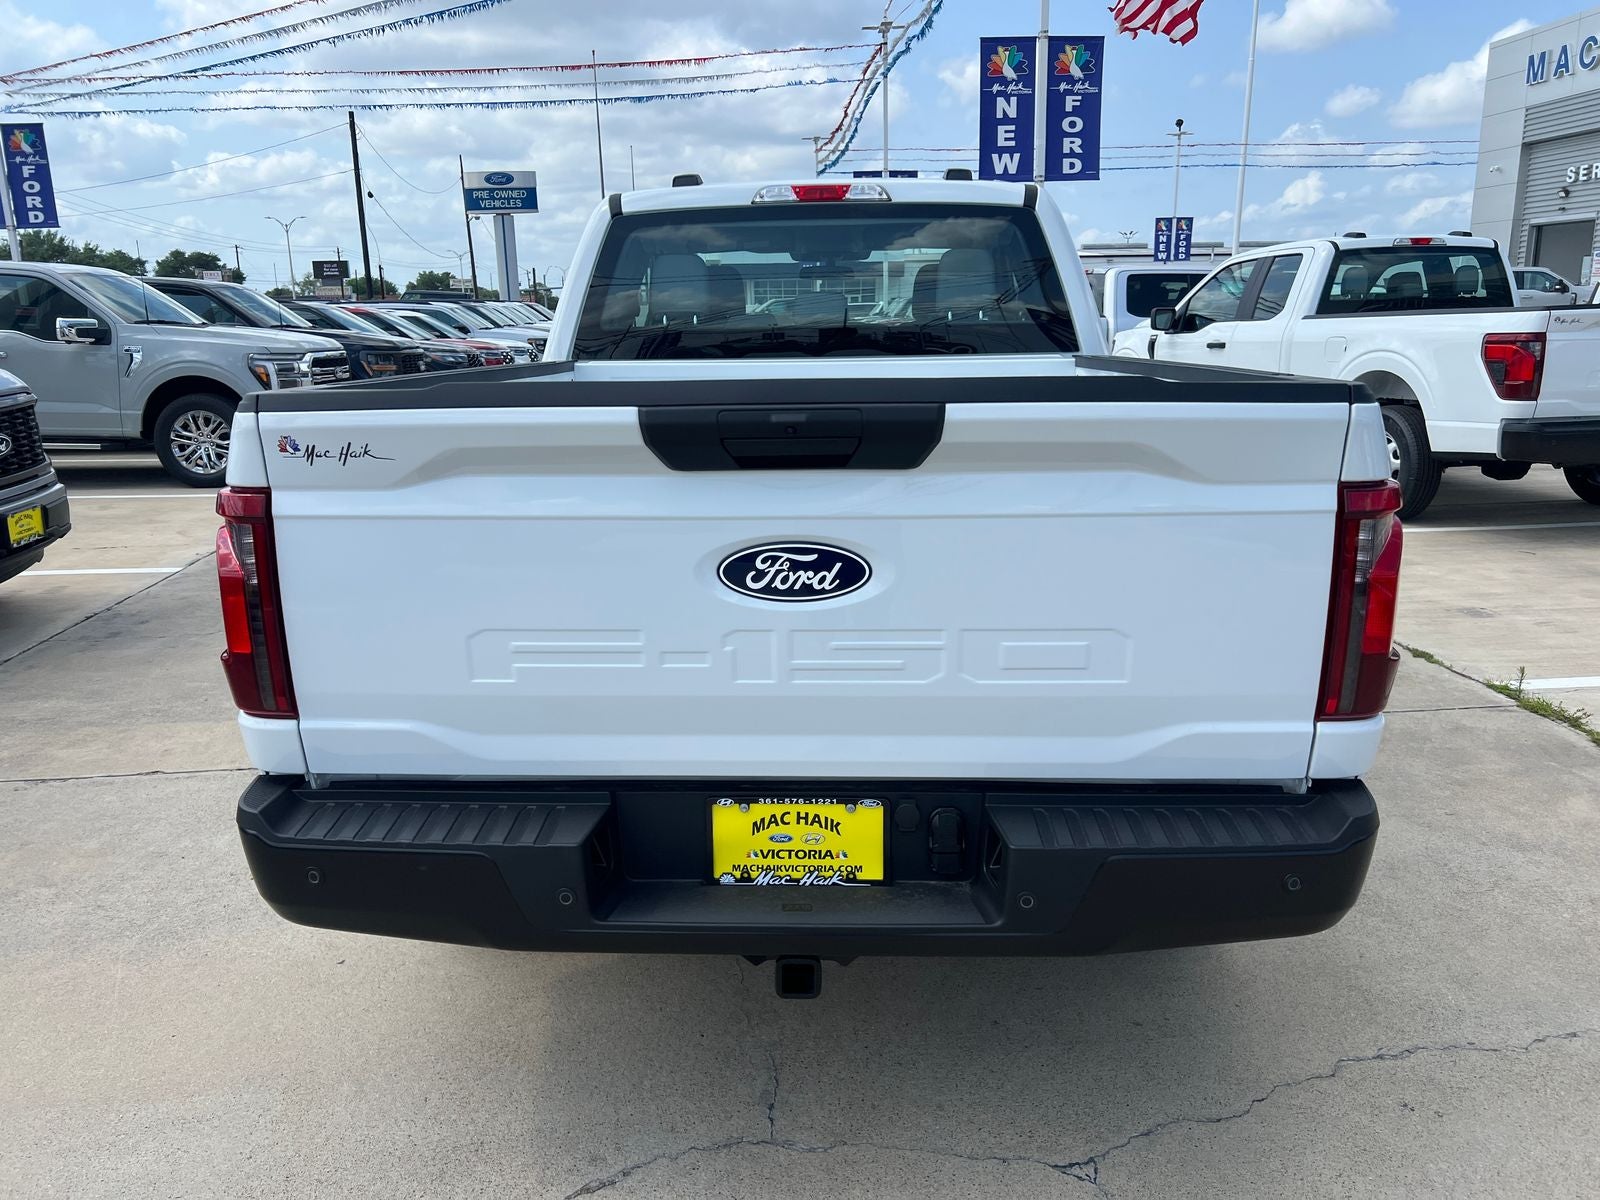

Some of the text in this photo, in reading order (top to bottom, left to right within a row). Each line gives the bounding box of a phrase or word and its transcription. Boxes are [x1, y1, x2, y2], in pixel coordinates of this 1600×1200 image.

[1526, 35, 1600, 85] MAC
[991, 96, 1021, 175] NEW
[1061, 95, 1084, 174] FORD
[21, 165, 45, 223] FORD
[479, 200, 522, 208] VEHICLES
[1157, 235, 1167, 260] NEW
[1178, 235, 1187, 259] FORD
[297, 441, 384, 466] Mac Haik
[745, 551, 843, 590] Ford
[466, 629, 1132, 684] F-150
[752, 811, 842, 836] MAC HAIK
[760, 849, 835, 860] VICTORIA
[732, 864, 863, 873] MACHAIKVICTORIA.COM
[746, 870, 857, 886] Mac Haik
